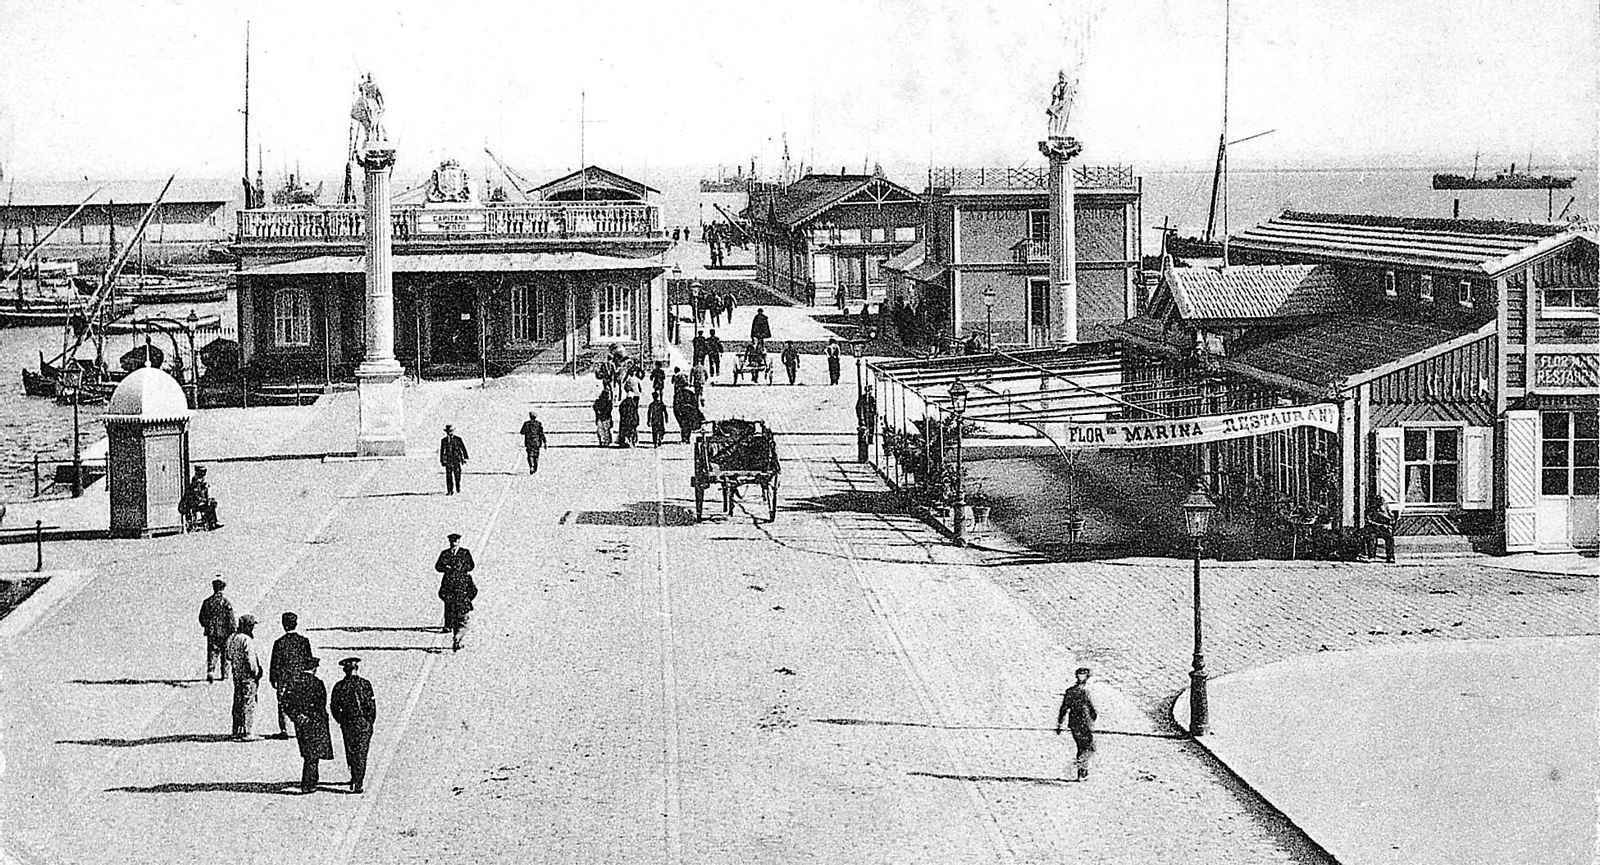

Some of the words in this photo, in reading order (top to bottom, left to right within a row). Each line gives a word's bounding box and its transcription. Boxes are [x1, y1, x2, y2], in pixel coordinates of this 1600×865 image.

[1540, 355, 1568, 368] FLOR
[1069, 426, 1106, 443] FLOR
[1124, 422, 1203, 443] MARINA
